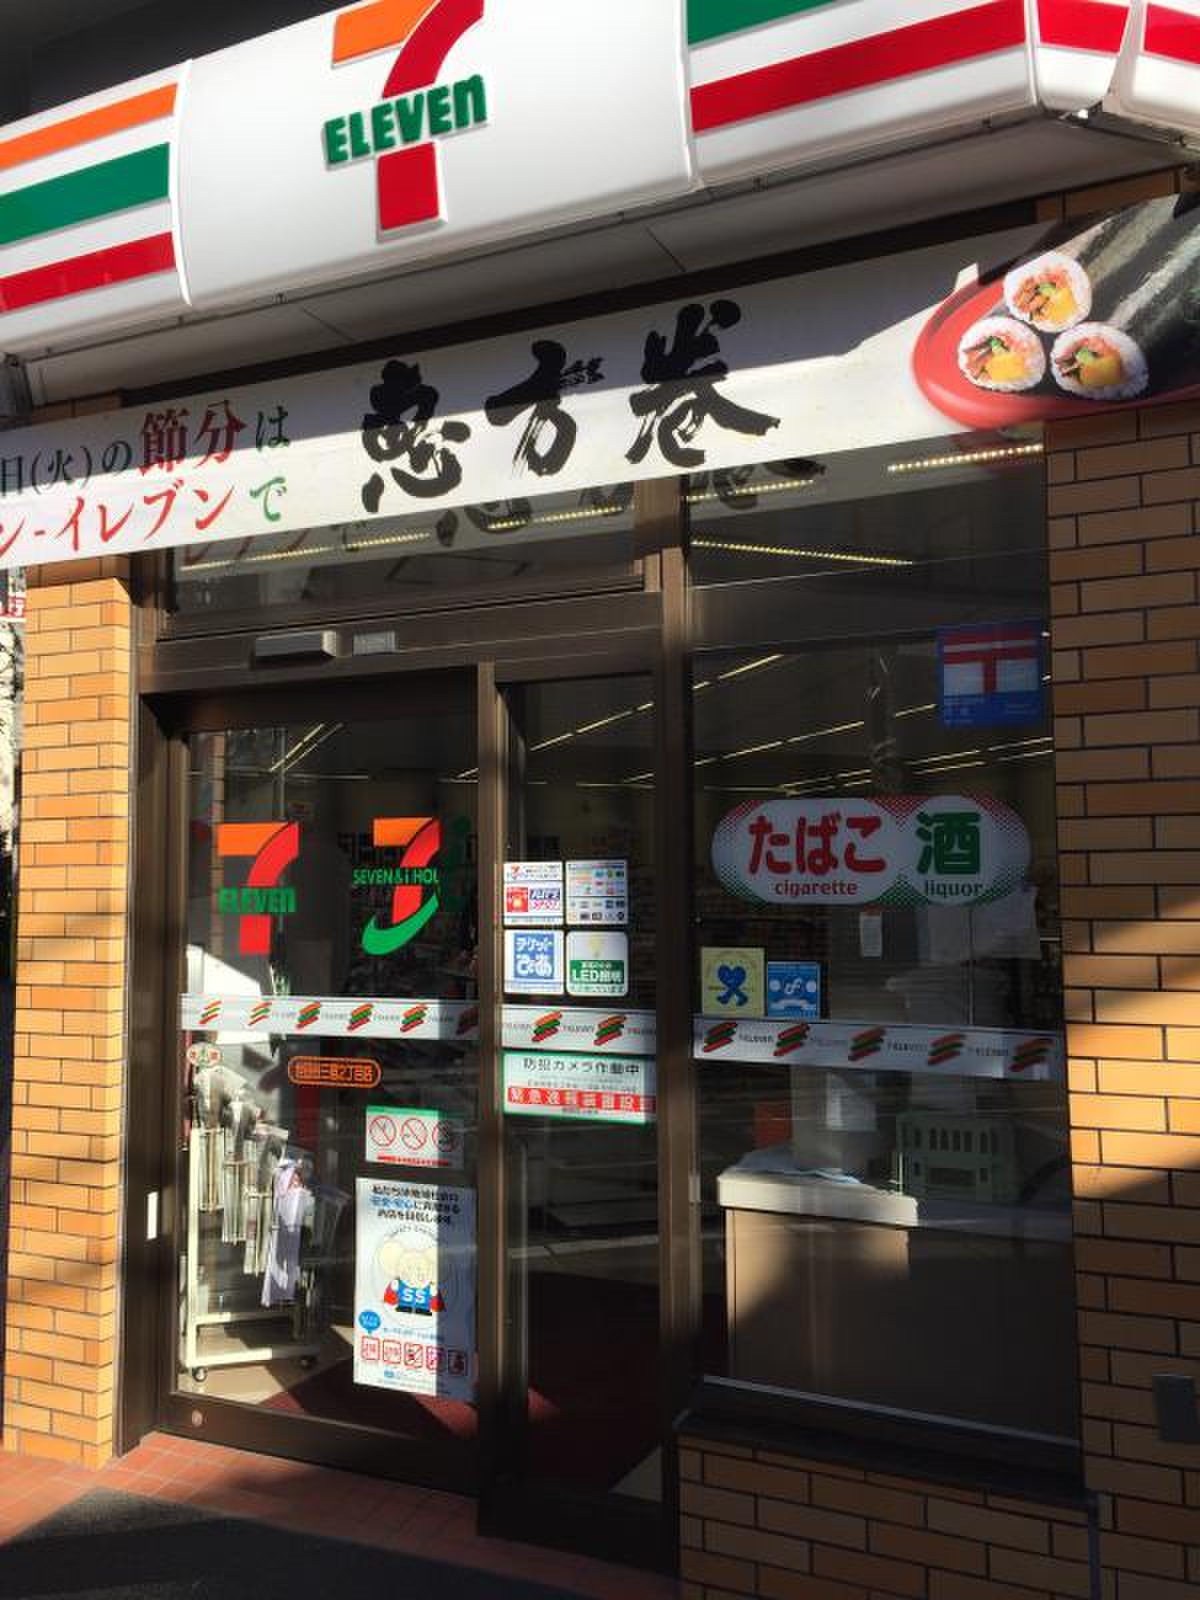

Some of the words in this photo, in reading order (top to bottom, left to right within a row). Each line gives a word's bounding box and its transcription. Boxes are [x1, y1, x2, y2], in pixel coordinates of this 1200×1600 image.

[362, 300, 781, 513] 恵方巻
[748, 811, 887, 876] たばこ
[916, 811, 982, 875] 酒
[774, 879, 858, 896] cigarette
[924, 880, 984, 897] liquor
[523, 1058, 640, 1076] 防犯カメラ作動中
[402, 1287, 426, 1304] SS
